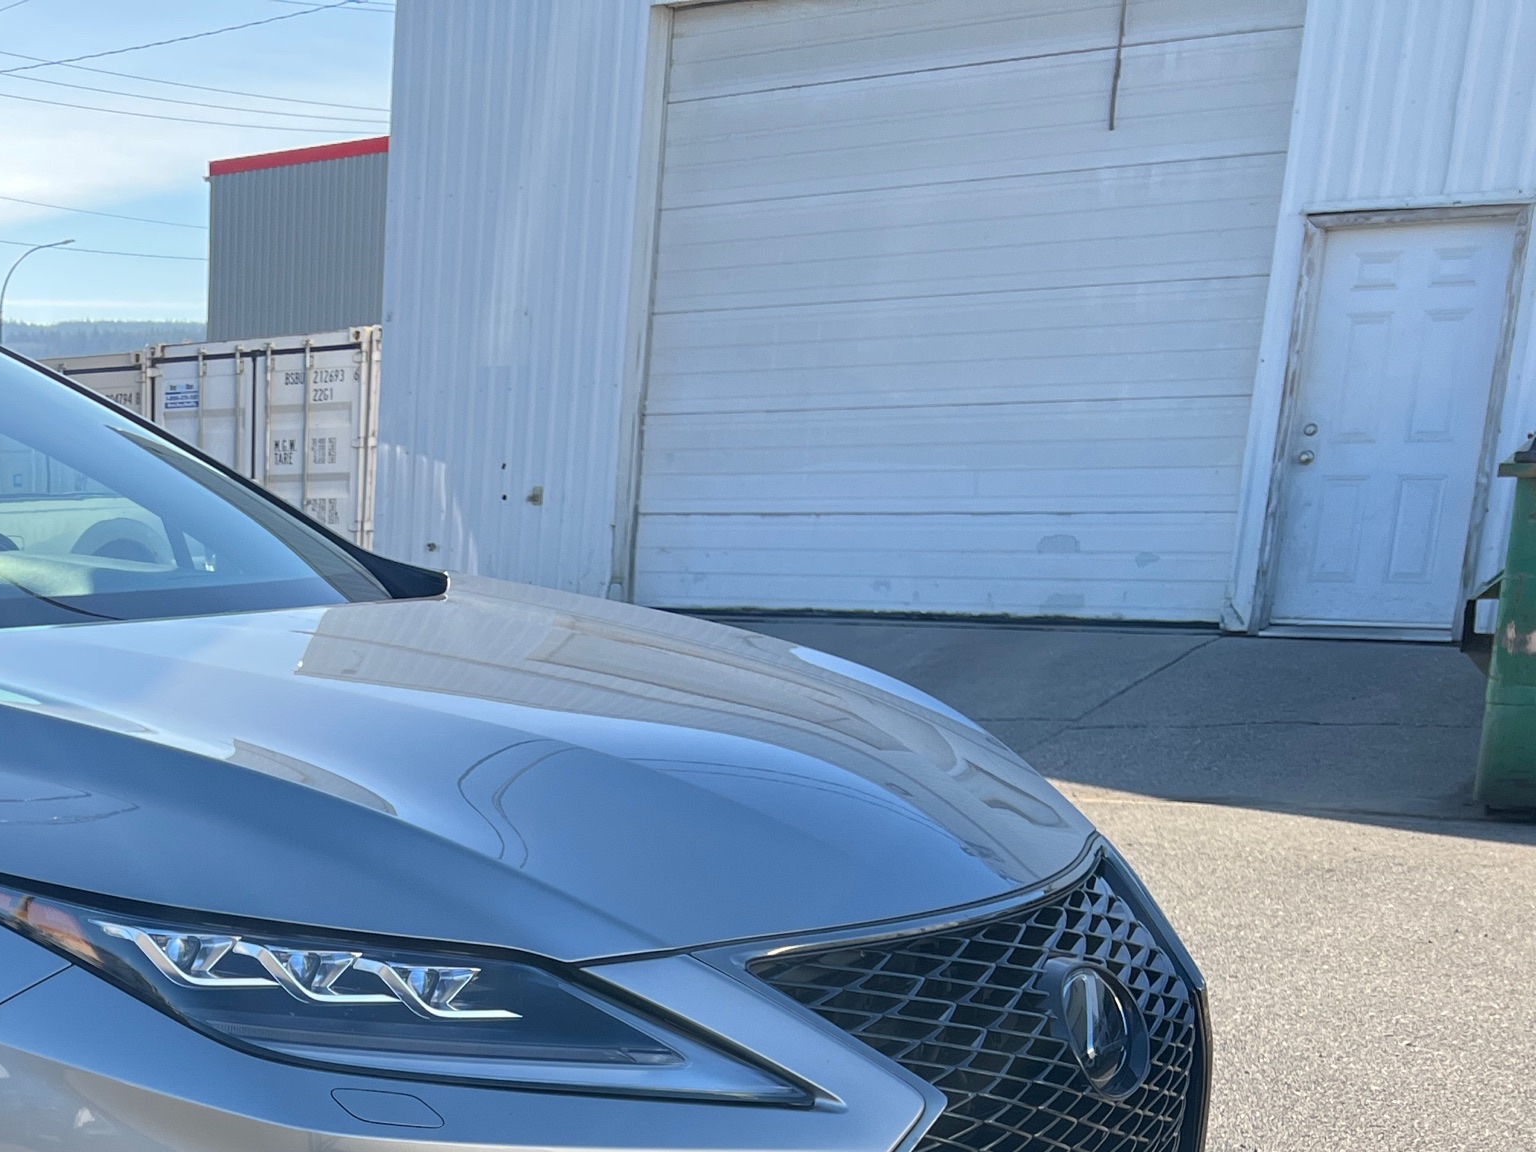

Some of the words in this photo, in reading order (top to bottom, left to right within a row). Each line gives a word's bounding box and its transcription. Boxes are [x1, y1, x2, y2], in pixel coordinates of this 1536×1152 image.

[312, 369, 345, 384] 212693
[105, 393, 132, 405] 4794
[274, 453, 293, 465] TARE
